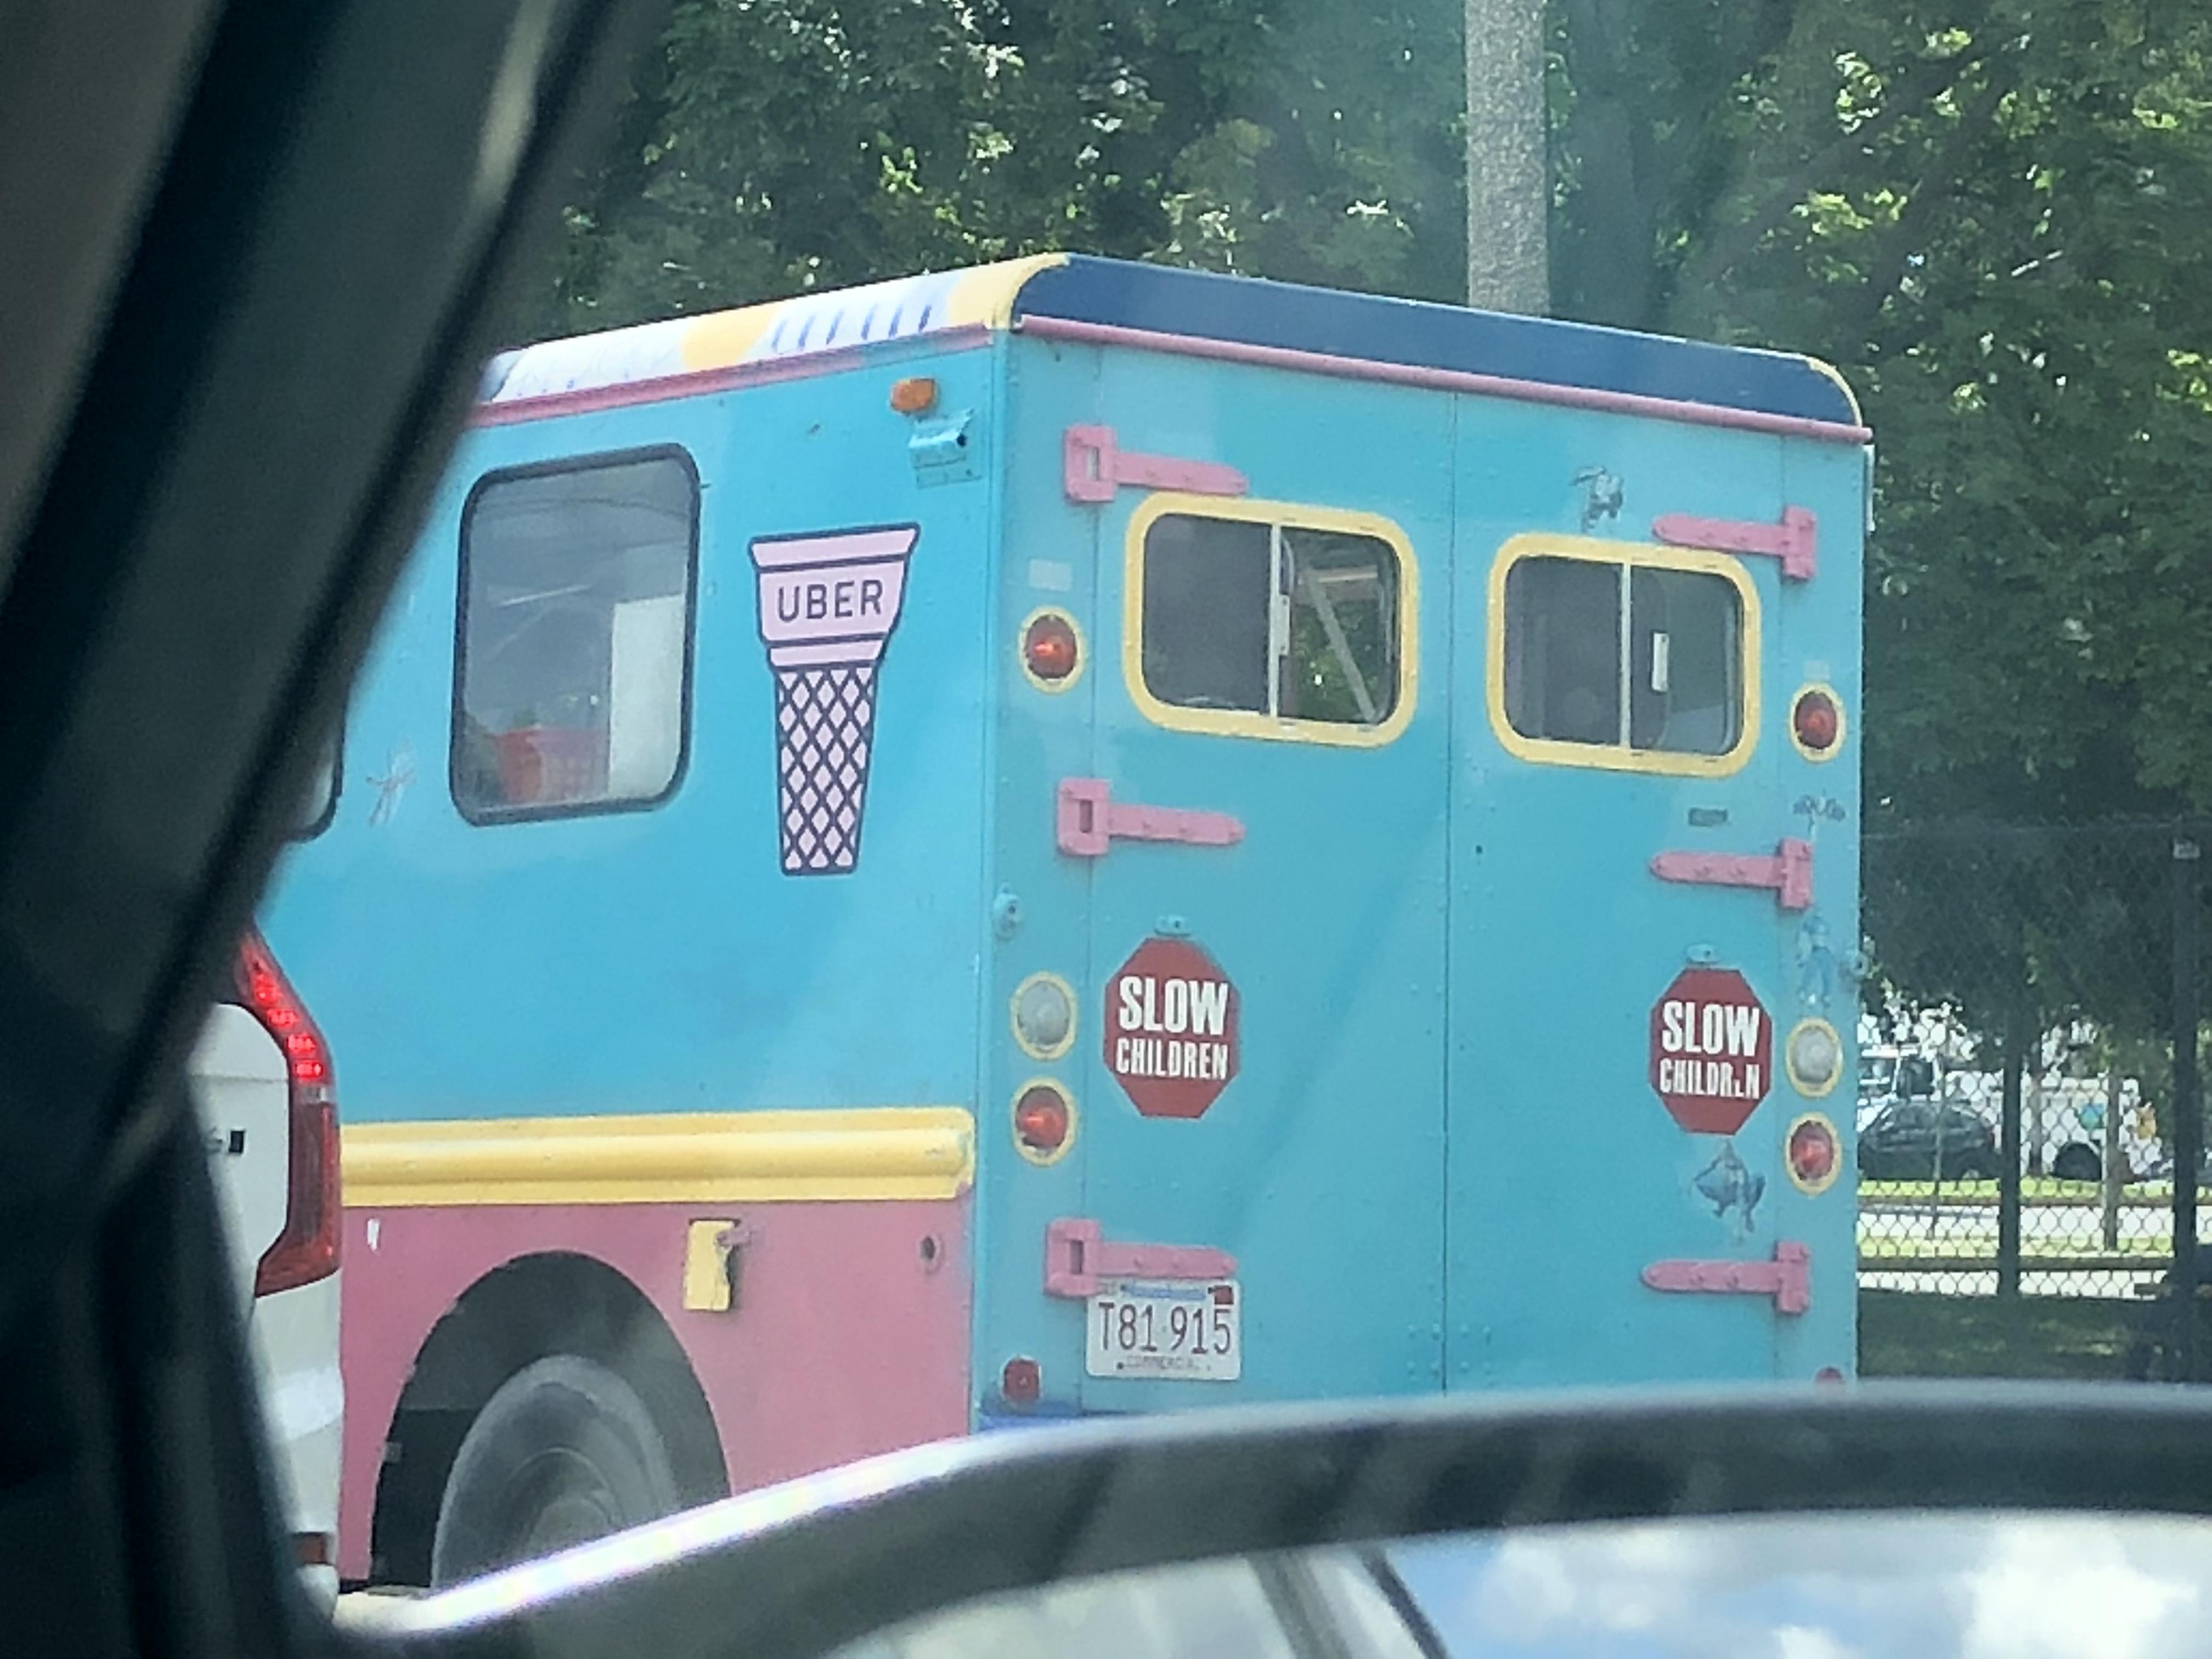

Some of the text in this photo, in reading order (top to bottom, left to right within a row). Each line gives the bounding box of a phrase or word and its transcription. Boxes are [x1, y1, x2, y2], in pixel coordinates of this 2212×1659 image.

[778, 579, 883, 622] UBER
[1119, 975, 1228, 1036] SLOW
[1662, 1001, 1760, 1057] SLOW
[1116, 1037, 1228, 1080] CHILDREN
[1098, 1302, 1231, 1355] T81 915
